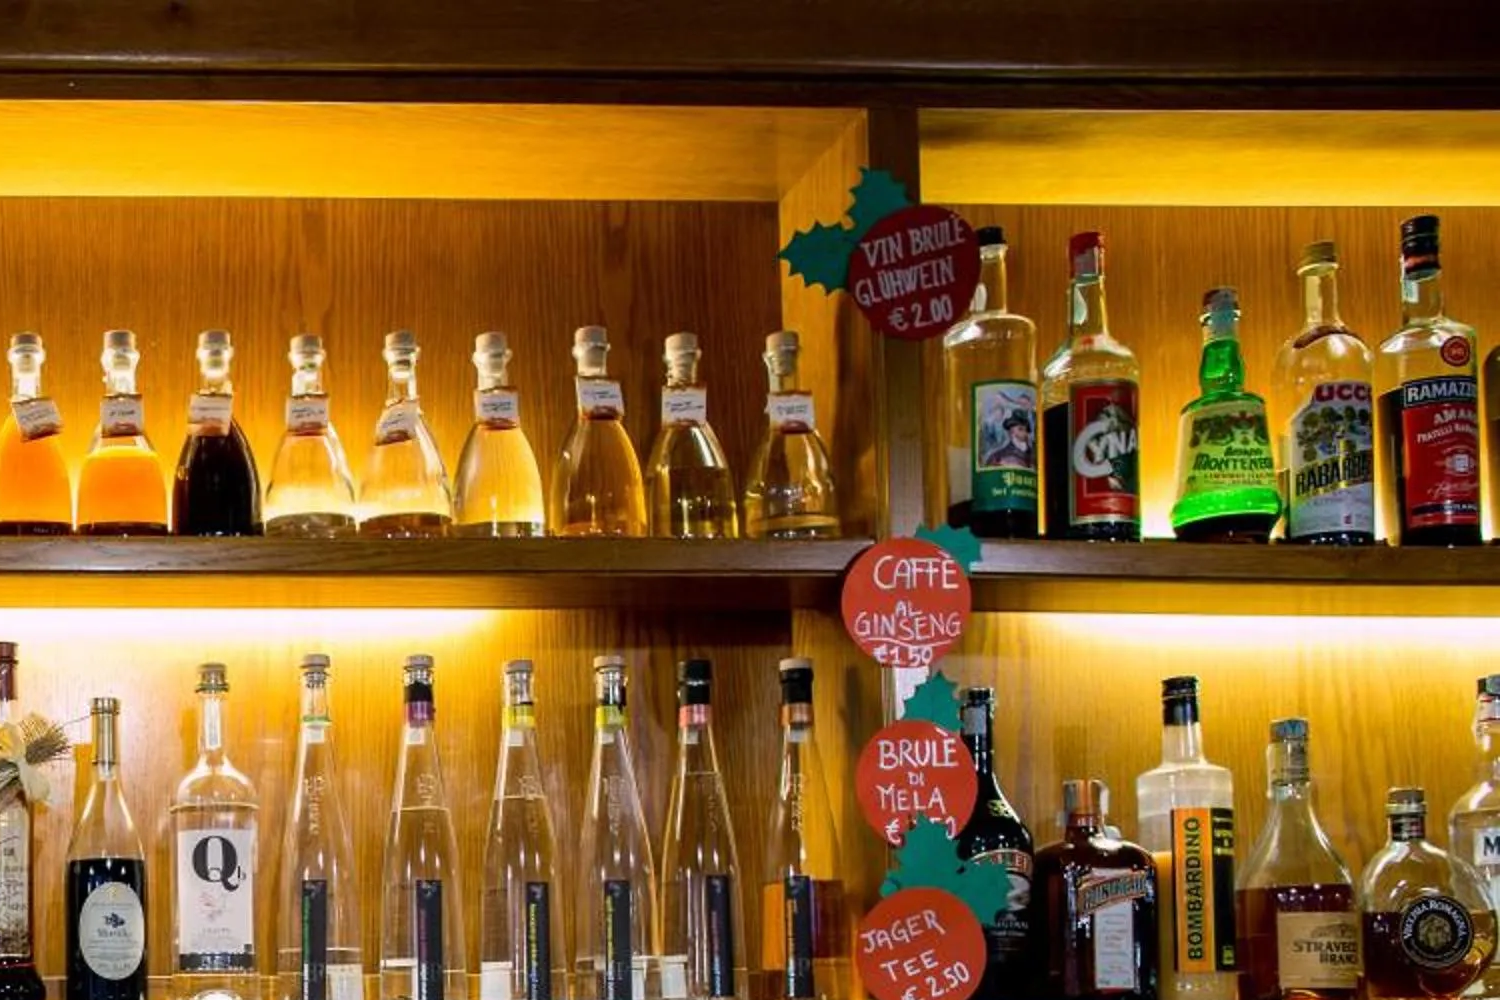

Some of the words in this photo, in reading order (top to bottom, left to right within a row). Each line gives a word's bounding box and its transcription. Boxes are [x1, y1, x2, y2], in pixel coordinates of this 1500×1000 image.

[860, 231, 903, 268] VIN
[895, 600, 923, 618] AL
[854, 611, 961, 641] GINSENG
[907, 771, 925, 787] DI
[875, 783, 947, 815] MELA
[1184, 817, 1203, 960] BOMBARDINO
[860, 909, 946, 954] JAGER
[879, 949, 939, 982] TEE
[925, 961, 970, 998] 2.50
